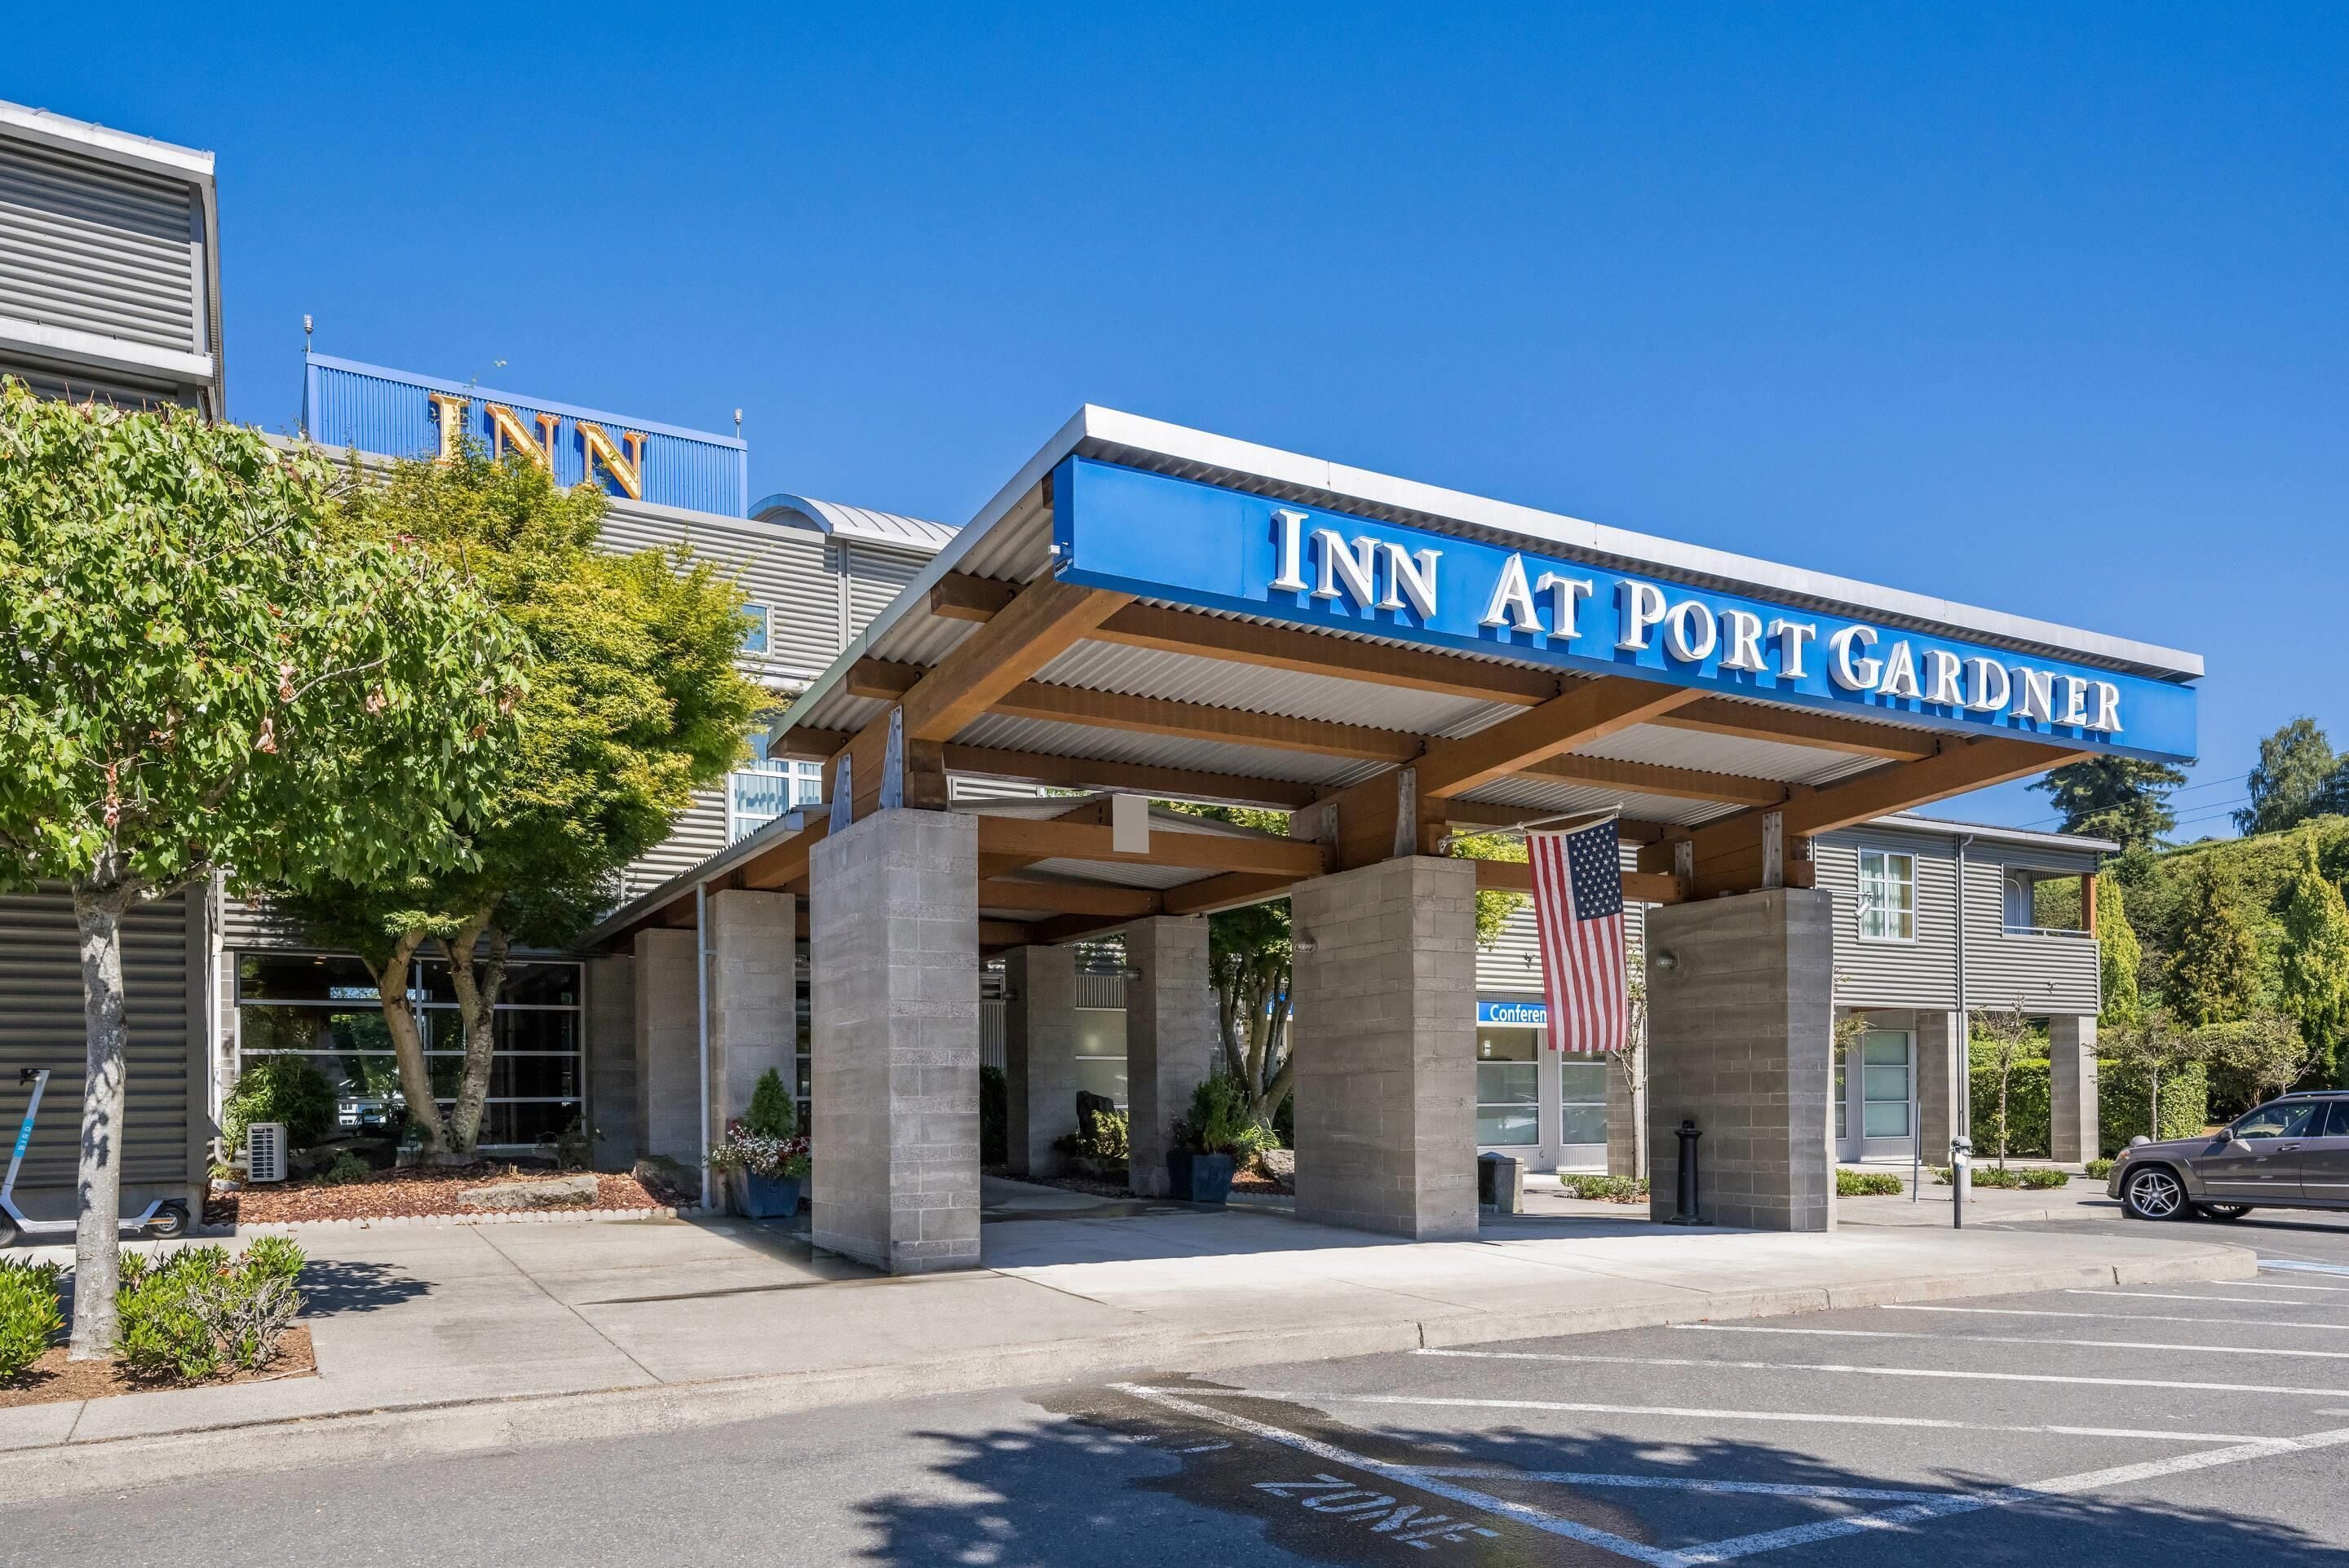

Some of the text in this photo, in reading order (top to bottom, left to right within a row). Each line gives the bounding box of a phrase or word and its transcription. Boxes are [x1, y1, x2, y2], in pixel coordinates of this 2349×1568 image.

[430, 392, 648, 501] INN
[1268, 508, 2123, 732] INN AT PORT GARDNER
[18, 1126, 32, 1151] BIRD
